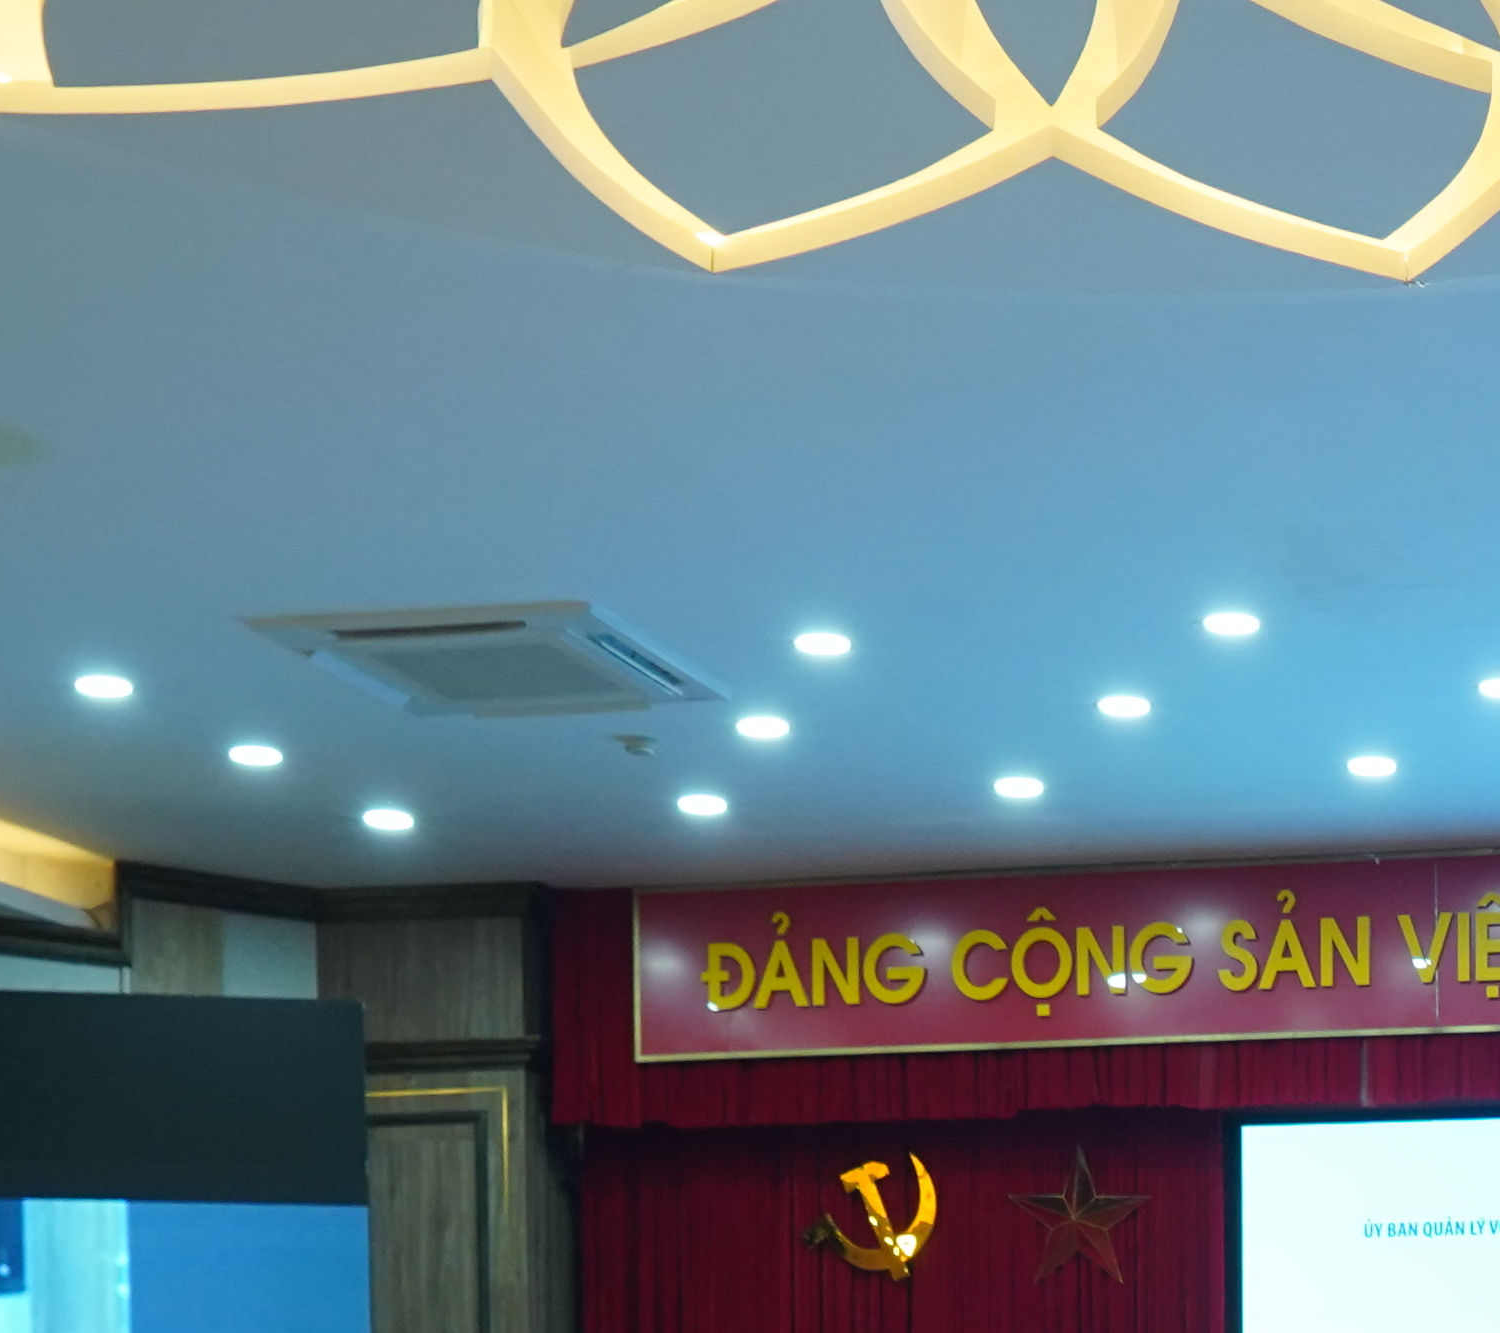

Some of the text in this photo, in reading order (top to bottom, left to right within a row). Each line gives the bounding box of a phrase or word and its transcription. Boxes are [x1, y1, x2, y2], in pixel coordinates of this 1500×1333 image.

[702, 912, 924, 1011] ĐẢNG
[951, 907, 1194, 1017] CỘNG
[1217, 889, 1372, 992] SẢN
[1363, 1219, 1383, 1239] ỦY
[1387, 1222, 1419, 1238] BAN
[1422, 1216, 1466, 1239] QUẢN
[1469, 1217, 1486, 1236] LÝ
